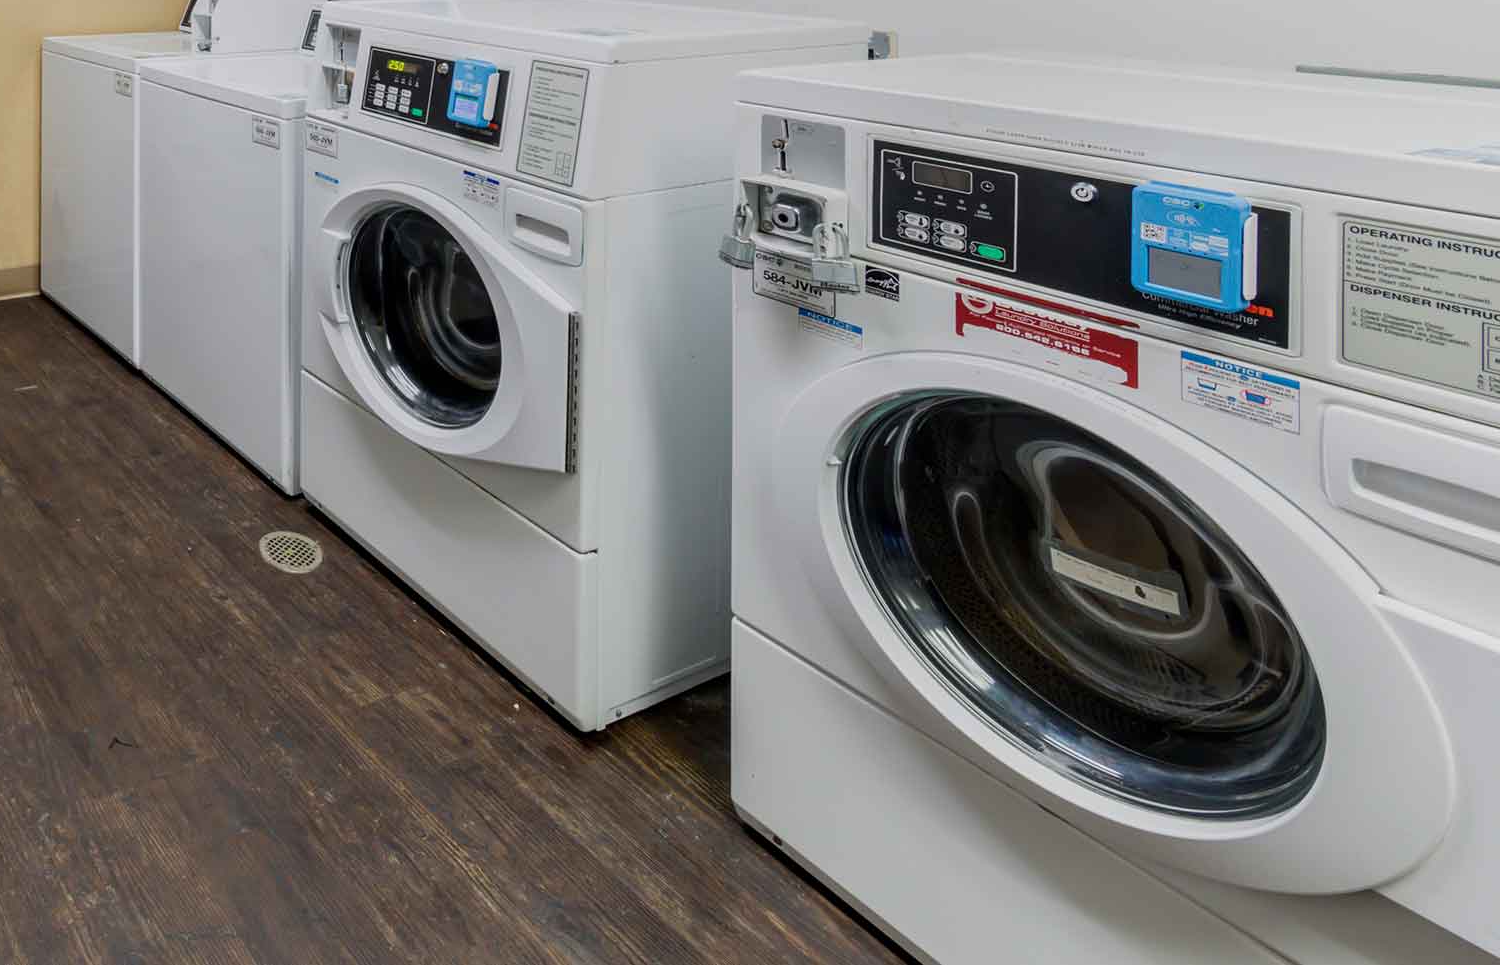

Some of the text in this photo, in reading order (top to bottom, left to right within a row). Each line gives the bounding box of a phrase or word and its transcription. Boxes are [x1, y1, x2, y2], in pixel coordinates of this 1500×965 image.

[1349, 224, 1433, 248] OPERATING
[1349, 283, 1432, 308] DISPENSER
[995, 308, 1037, 326] Laundry
[1039, 321, 1090, 340] Solutions
[1214, 359, 1263, 378] NOTICE
